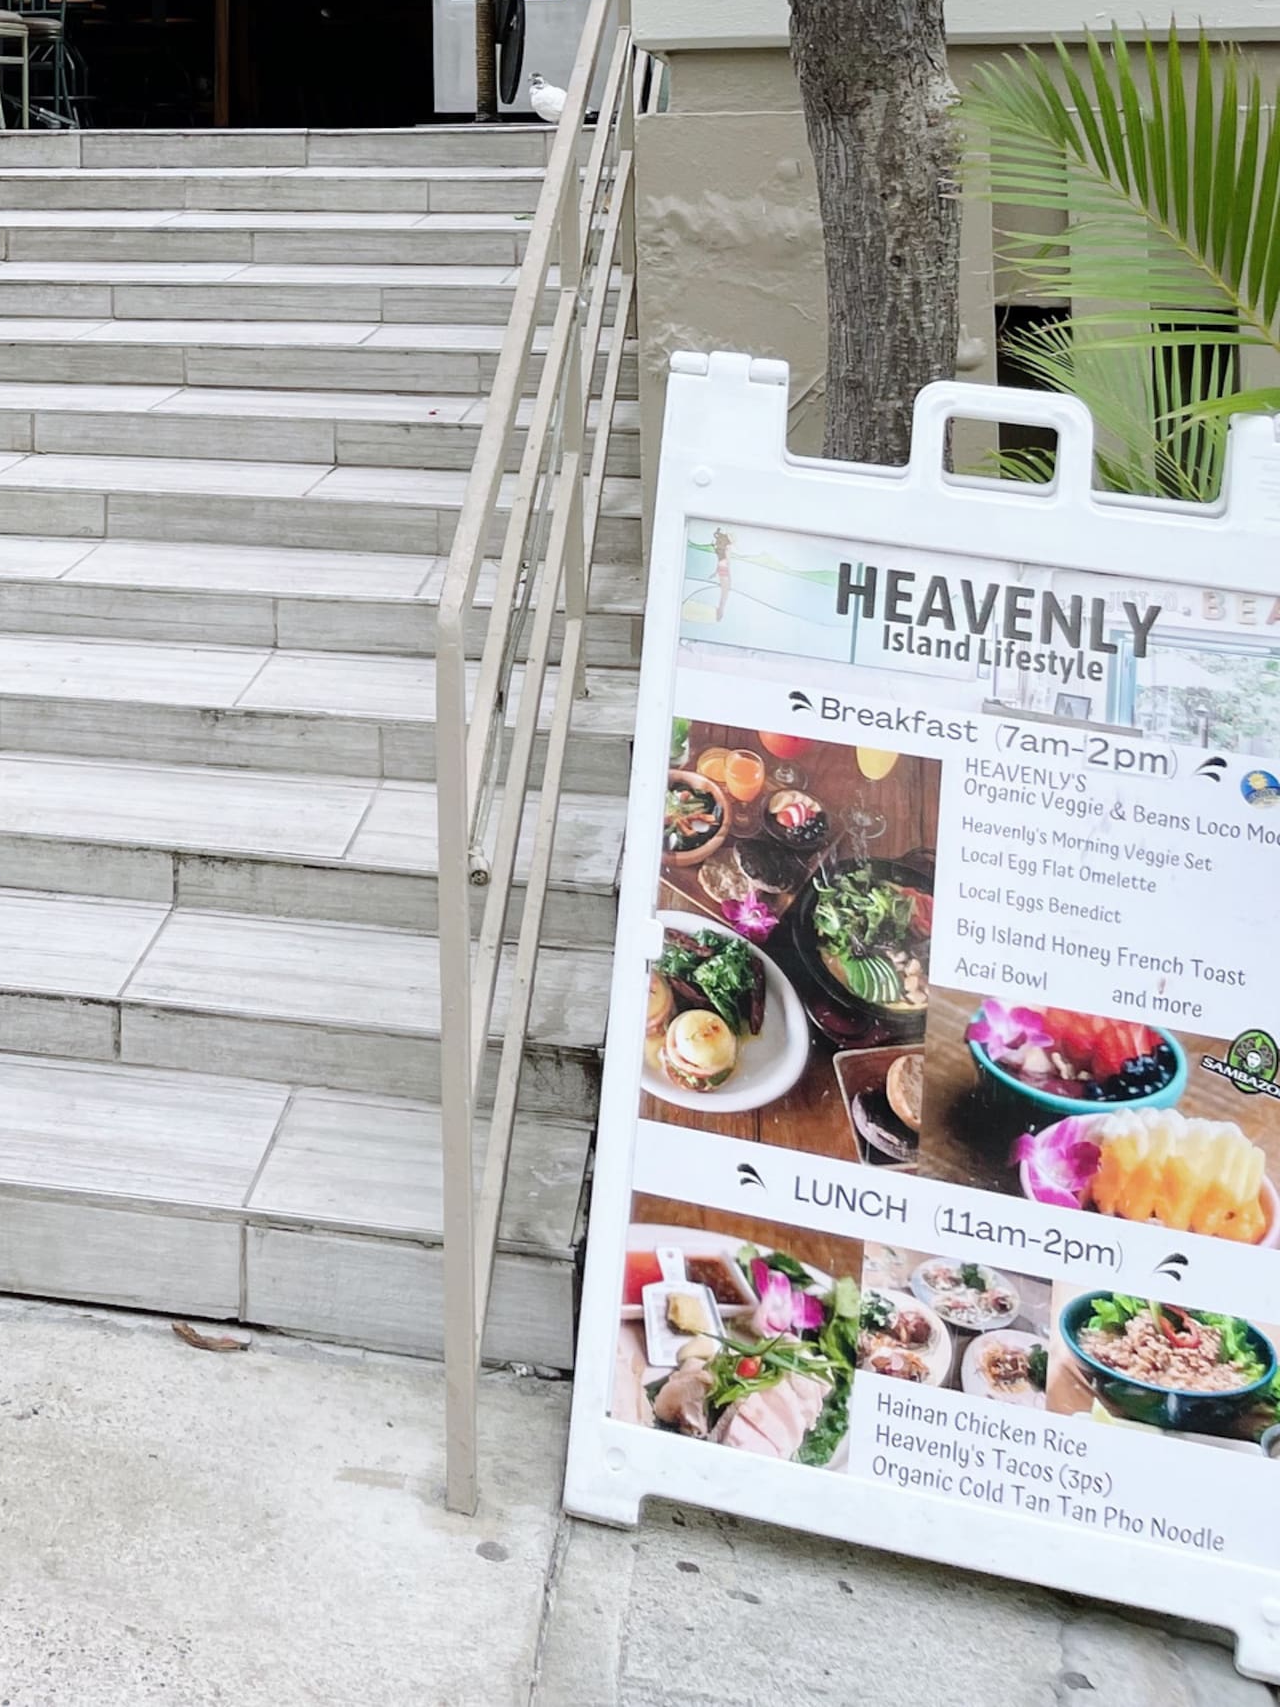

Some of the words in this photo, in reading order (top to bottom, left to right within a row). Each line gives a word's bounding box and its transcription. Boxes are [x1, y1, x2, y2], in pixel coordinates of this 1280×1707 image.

[836, 562, 1162, 658] HEAVENLY
[882, 624, 970, 662] Island
[978, 638, 1104, 684] Lifestyle
[820, 696, 978, 743] Breakfast
[995, 723, 1178, 780] (7am-2pm)
[966, 757, 1087, 793] HEAVENLY'S
[962, 816, 1047, 846] Heavenly's
[1052, 830, 1119, 860] Morning
[1123, 843, 1180, 869] Veggie
[1184, 852, 1212, 872] Set
[964, 777, 1036, 804] Organic
[1041, 791, 1104, 819] Veggie
[1109, 801, 1126, 821] &
[1133, 804, 1190, 832] Beans
[1196, 816, 1241, 839] Loco
[1247, 823, 1280, 847] Mo
[961, 846, 1003, 867] Local
[1008, 853, 1037, 877] Egg
[1042, 858, 1074, 879] Flat
[1079, 865, 1157, 893] Omelette
[959, 882, 1001, 903] Local
[1006, 889, 1044, 913] Eggs
[1048, 896, 1122, 924] Benedict
[957, 917, 985, 944] Big
[992, 925, 1046, 951] Island
[1052, 934, 1111, 967] Honey
[1117, 946, 1184, 976] French
[1190, 958, 1246, 986] Toast
[954, 956, 997, 980] Acai
[1001, 964, 1048, 991] Bowl
[1112, 988, 1146, 1008] and
[1152, 995, 1203, 1018] more
[1202, 1056, 1280, 1098] SAMBAZO
[793, 1174, 908, 1223] LUNCH
[933, 1203, 1124, 1274] (11am-2pm)
[877, 1391, 948, 1426] Hainan
[954, 1410, 1036, 1446] Chicken
[1043, 1428, 1088, 1457] Rice
[876, 1423, 985, 1469] Heavenly's
[992, 1448, 1054, 1483] Tacos
[1059, 1463, 1113, 1498] (3ps)
[872, 1455, 953, 1488] Organic
[959, 1475, 1004, 1503] Cold
[1011, 1484, 1050, 1513] Tan
[1057, 1495, 1097, 1523] Tan
[1103, 1506, 1144, 1534] Pho
[1150, 1517, 1225, 1552] Noodle
